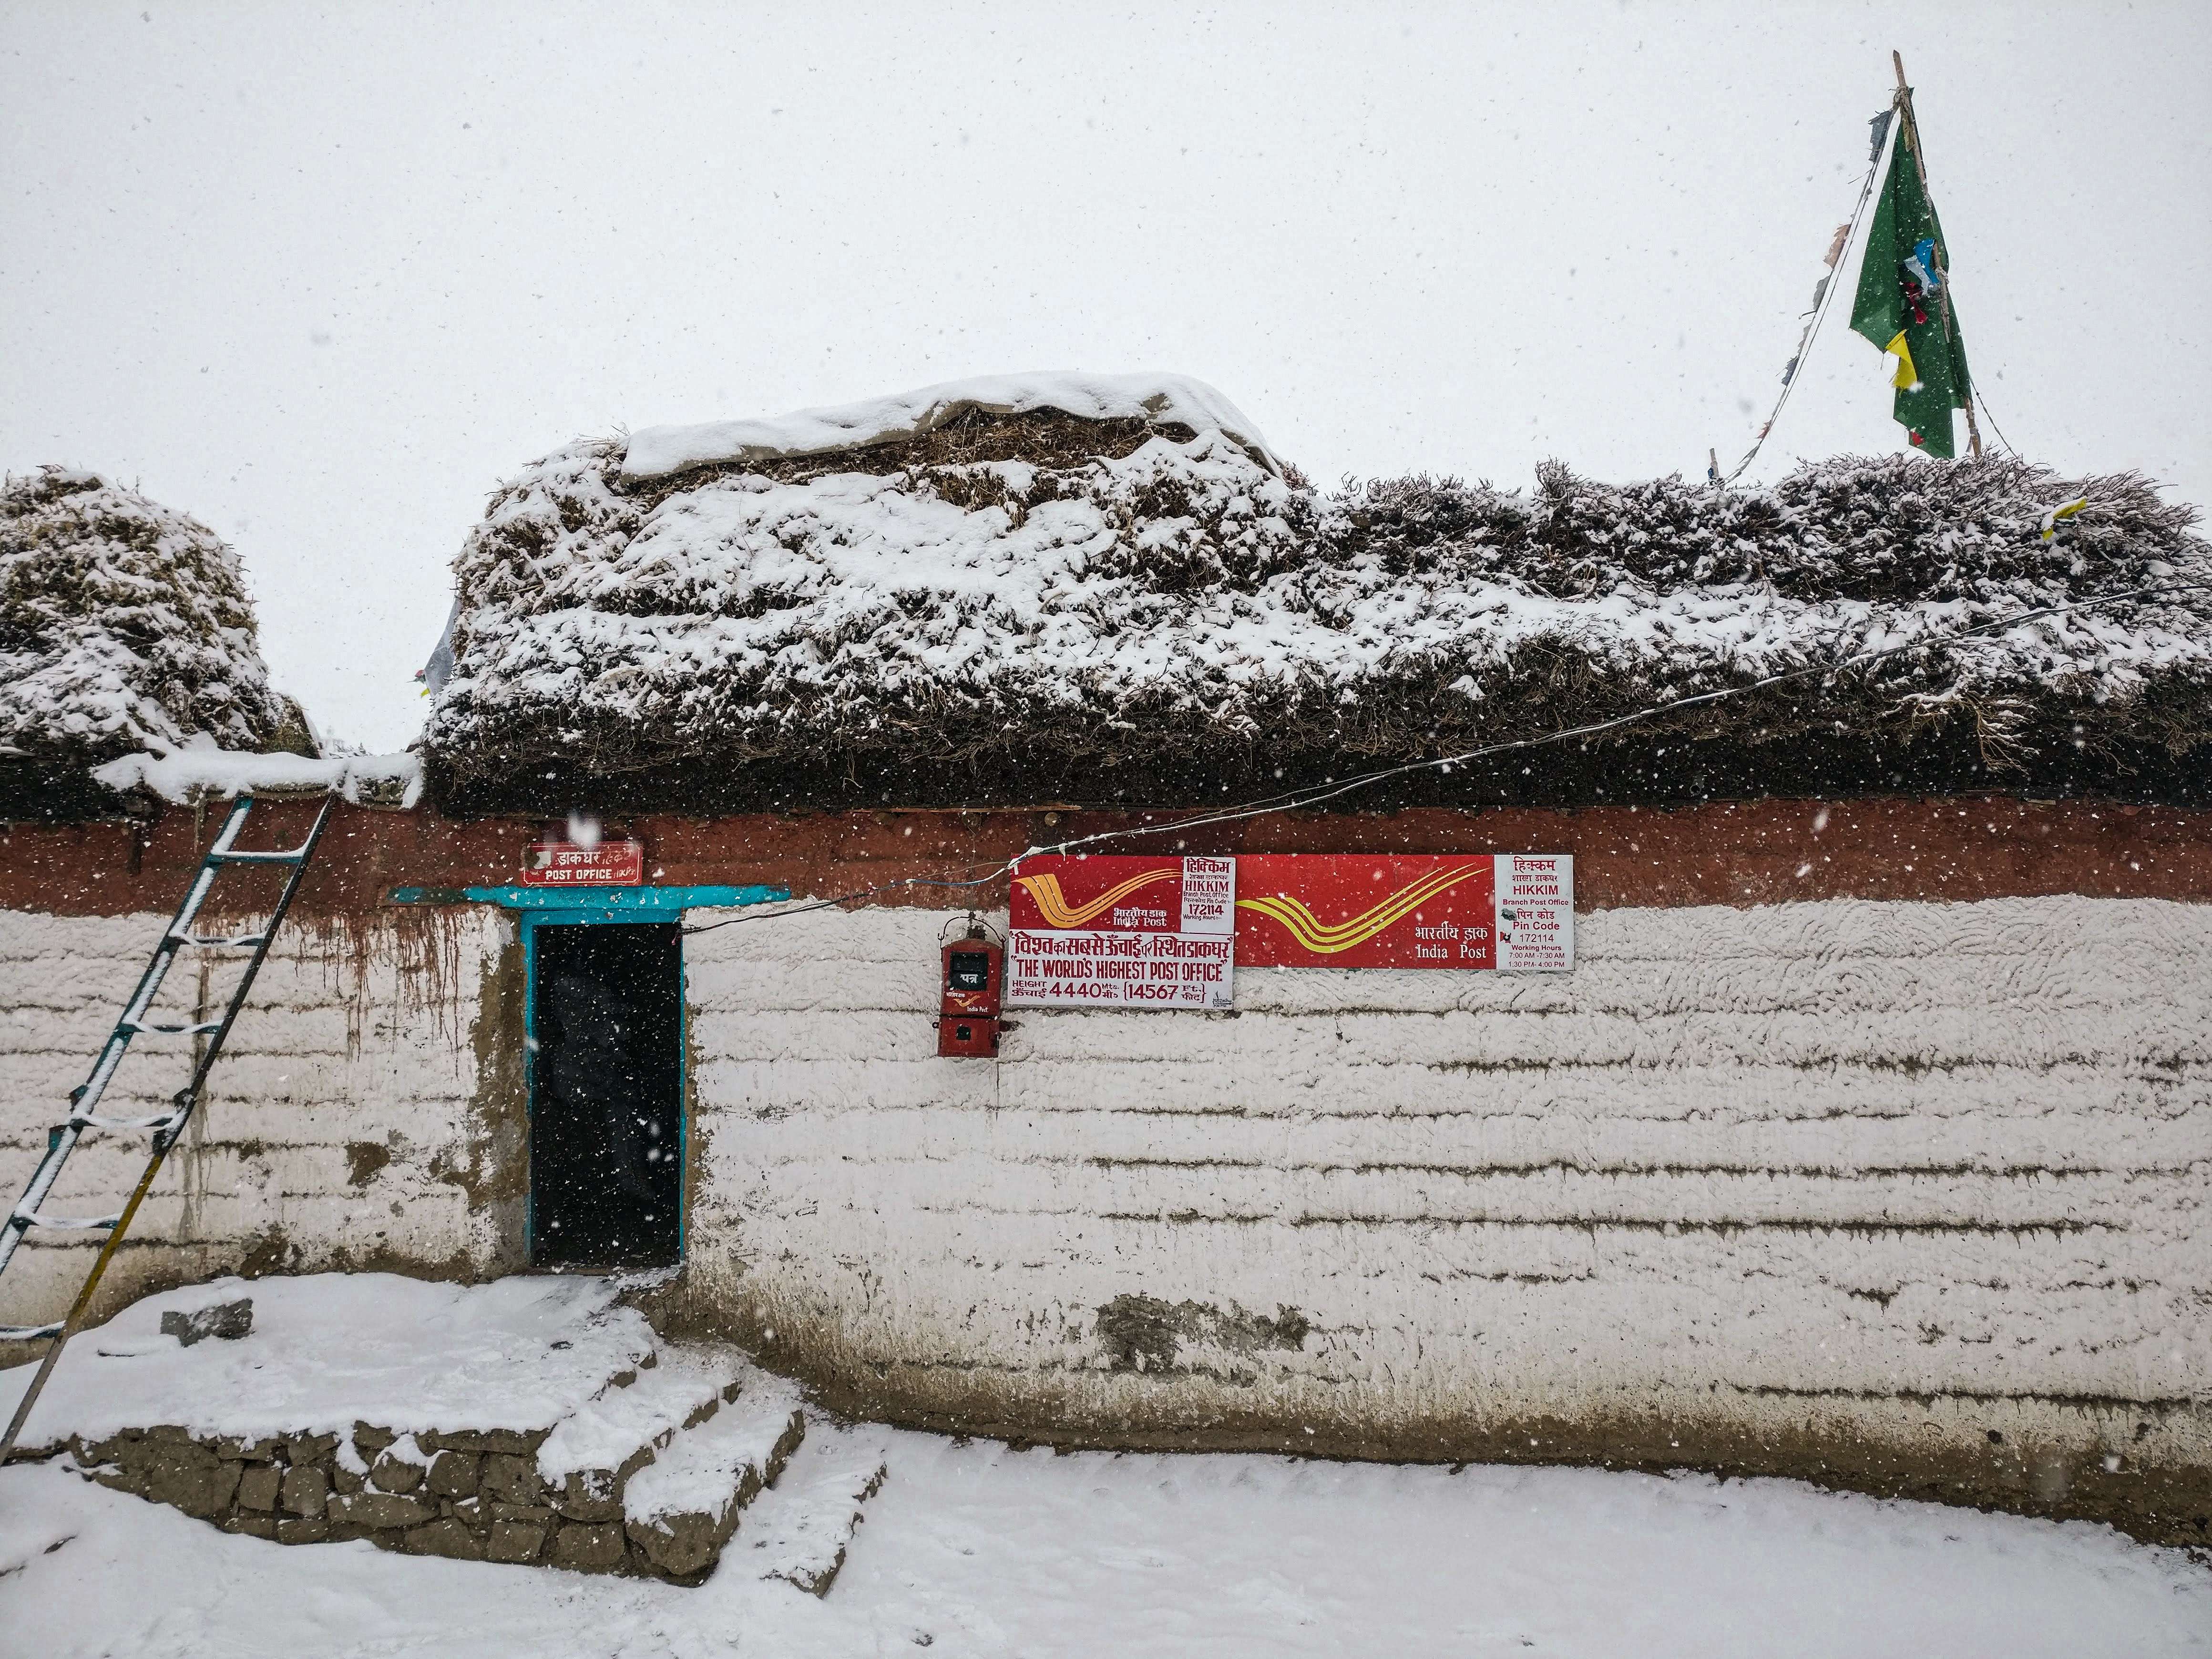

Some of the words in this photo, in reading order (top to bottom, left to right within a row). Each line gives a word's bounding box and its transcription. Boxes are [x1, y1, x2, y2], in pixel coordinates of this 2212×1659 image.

[545, 869, 572, 880] POST
[576, 869, 612, 880] OFFICE
[1184, 880, 1229, 892] HIKKIM
[1513, 885, 1558, 895] HIKKIM
[1114, 907, 1148, 917] भारतीय
[1189, 903, 1225, 915] 172114
[1516, 908, 1534, 919] पिन
[1537, 908, 1555, 919] कोड
[1113, 916, 1139, 926] India
[1143, 917, 1167, 926] Post
[1513, 922, 1529, 930] Pin
[1533, 921, 1560, 930] Code
[1415, 921, 1459, 940] भारतीय
[1462, 928, 1488, 941] डाक
[1520, 934, 1554, 942] 172114
[1054, 941, 1067, 956] का
[1065, 933, 1106, 956] सबसे
[1416, 944, 1448, 958] India
[1460, 944, 1487, 958] Post
[1042, 957, 1093, 978] WORLD’S
[1096, 960, 1147, 980] HIGHEST
[1150, 962, 1179, 981] POST
[960, 974, 979, 984] पत्र
[1049, 982, 1102, 998] 4440
